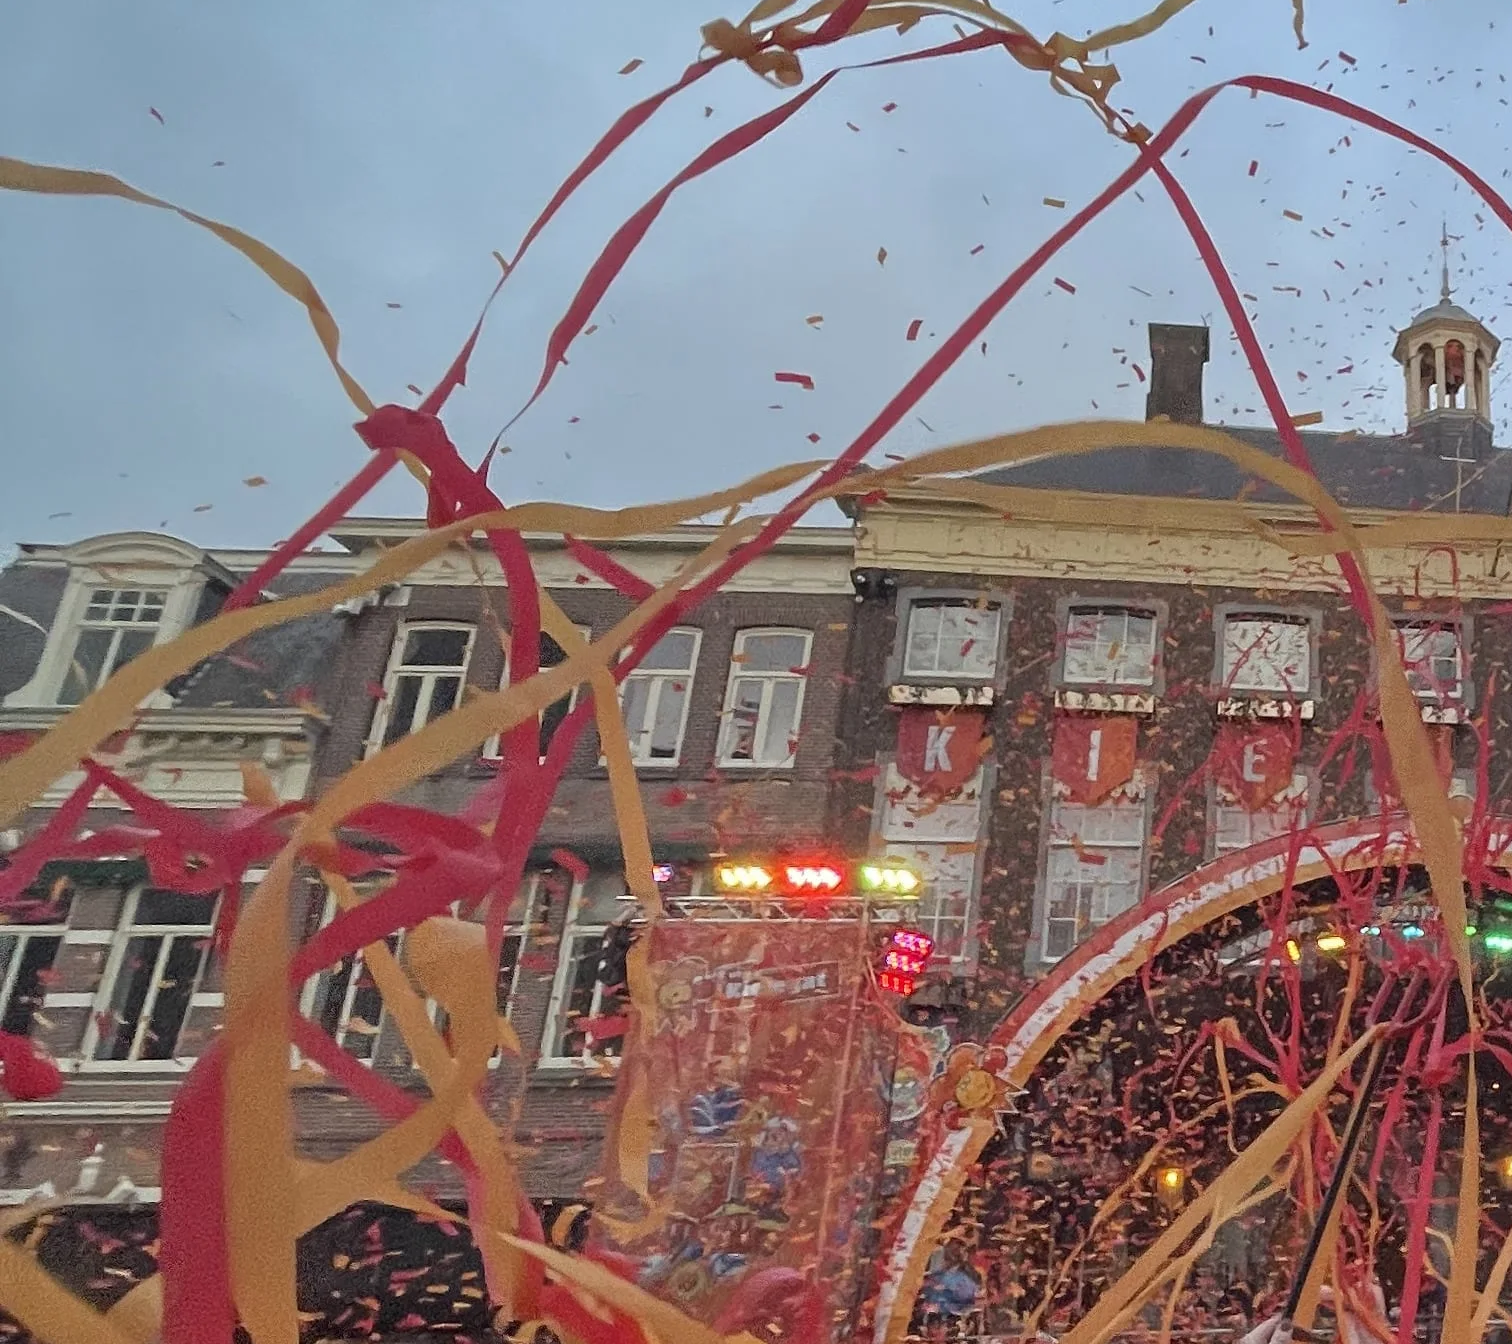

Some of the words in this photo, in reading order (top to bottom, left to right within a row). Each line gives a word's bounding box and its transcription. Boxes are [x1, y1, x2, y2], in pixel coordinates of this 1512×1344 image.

[923, 725, 956, 772] K
[1086, 729, 1101, 782] I
[1243, 738, 1267, 783] E
